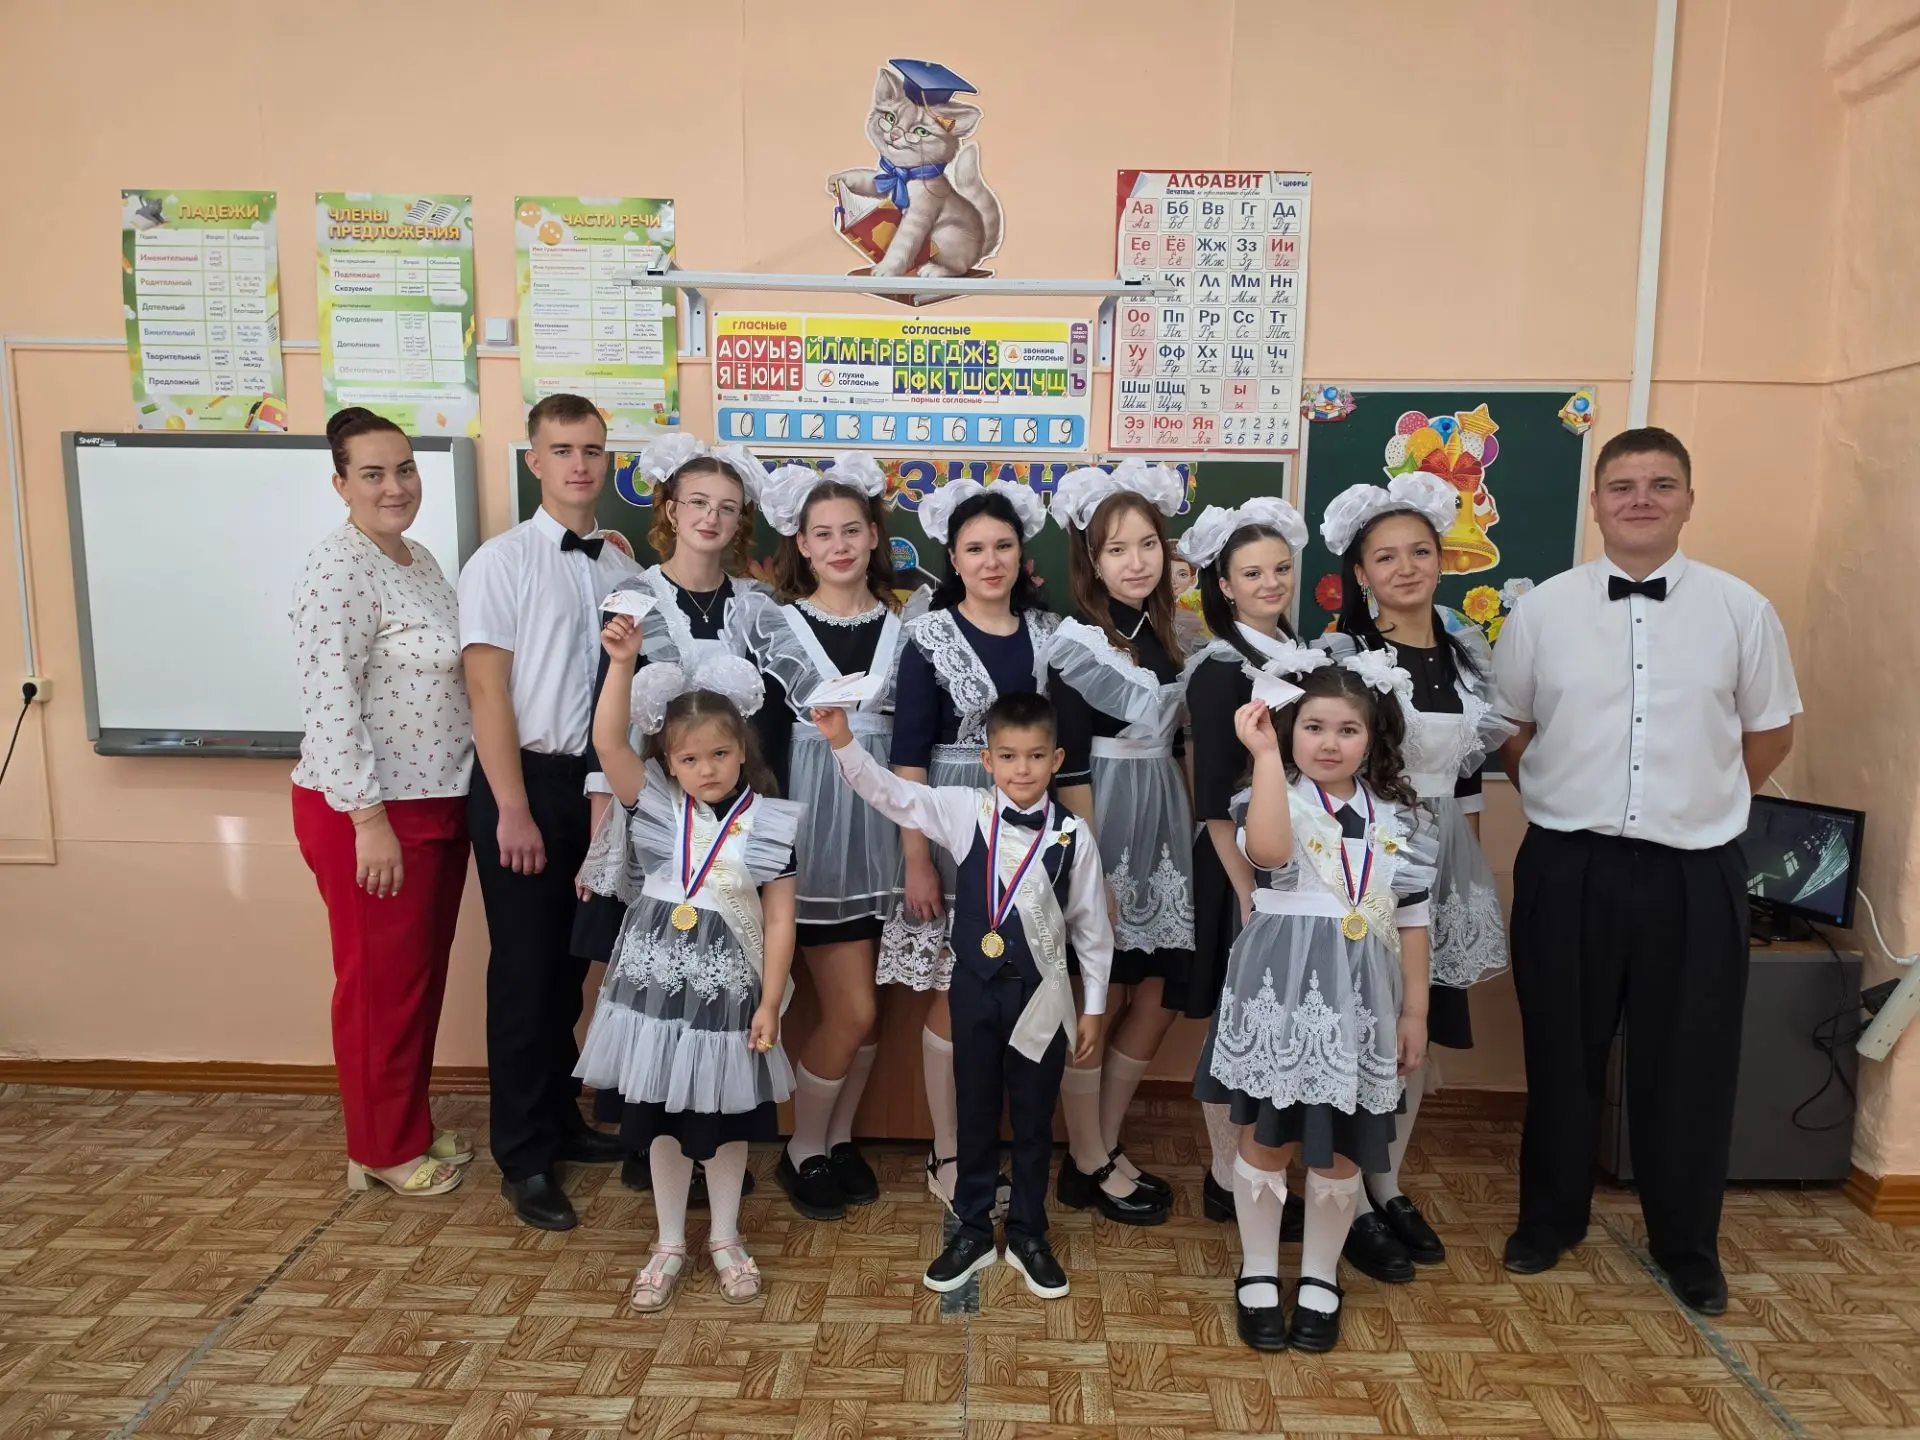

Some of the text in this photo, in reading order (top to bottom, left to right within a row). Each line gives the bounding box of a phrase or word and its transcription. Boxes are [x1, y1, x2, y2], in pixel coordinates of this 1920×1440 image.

[1167, 174, 1263, 188] АЛФАВИТ
[179, 204, 259, 222] ПАДЕЖИ
[329, 208, 388, 223] ЧЛЕНЫ
[1132, 201, 1296, 218] Аа Бб Вв Гг Дд
[563, 214, 661, 228] ЧАСТИ РЕЧИ
[329, 225, 460, 242] ПРЕДЛОЖЕНИЯ
[1132, 236, 1293, 251] Ее Ёё Жж Зз Ии
[335, 271, 380, 279] Подлежащее
[1200, 275, 1220, 287] Лл
[1231, 275, 1260, 287] Мм
[1271, 275, 1292, 288] Нн
[335, 285, 372, 293] Сказуемое
[142, 302, 185, 311] Дательный
[733, 319, 787, 330] гласные
[1128, 310, 1287, 325] Оо Пп Рр Сс Тт
[144, 328, 195, 336] Винительный
[902, 325, 971, 335] согласные
[146, 352, 201, 361] Творительный
[719, 340, 801, 359] А О У Ы Э
[807, 338, 997, 365] Й Л М Н Р Б В Г Д Ж З
[1129, 345, 1287, 360] Уу Фф Хх Цц Чч
[720, 364, 799, 386] Я Ё Ю И Е
[895, 371, 1067, 393] П Ф К Т Ш С Х Ц Ч Щ
[1122, 381, 1149, 393] Шш
[1156, 381, 1185, 395] Щщ
[740, 412, 1072, 443] 0 1 2 3 4 5 6 7 8 9
[1125, 417, 1213, 429] Ээ Юю Яя
[1224, 418, 1288, 429] 0 1 2 3 4
[1225, 434, 1288, 444] 5 6 7 8 9
